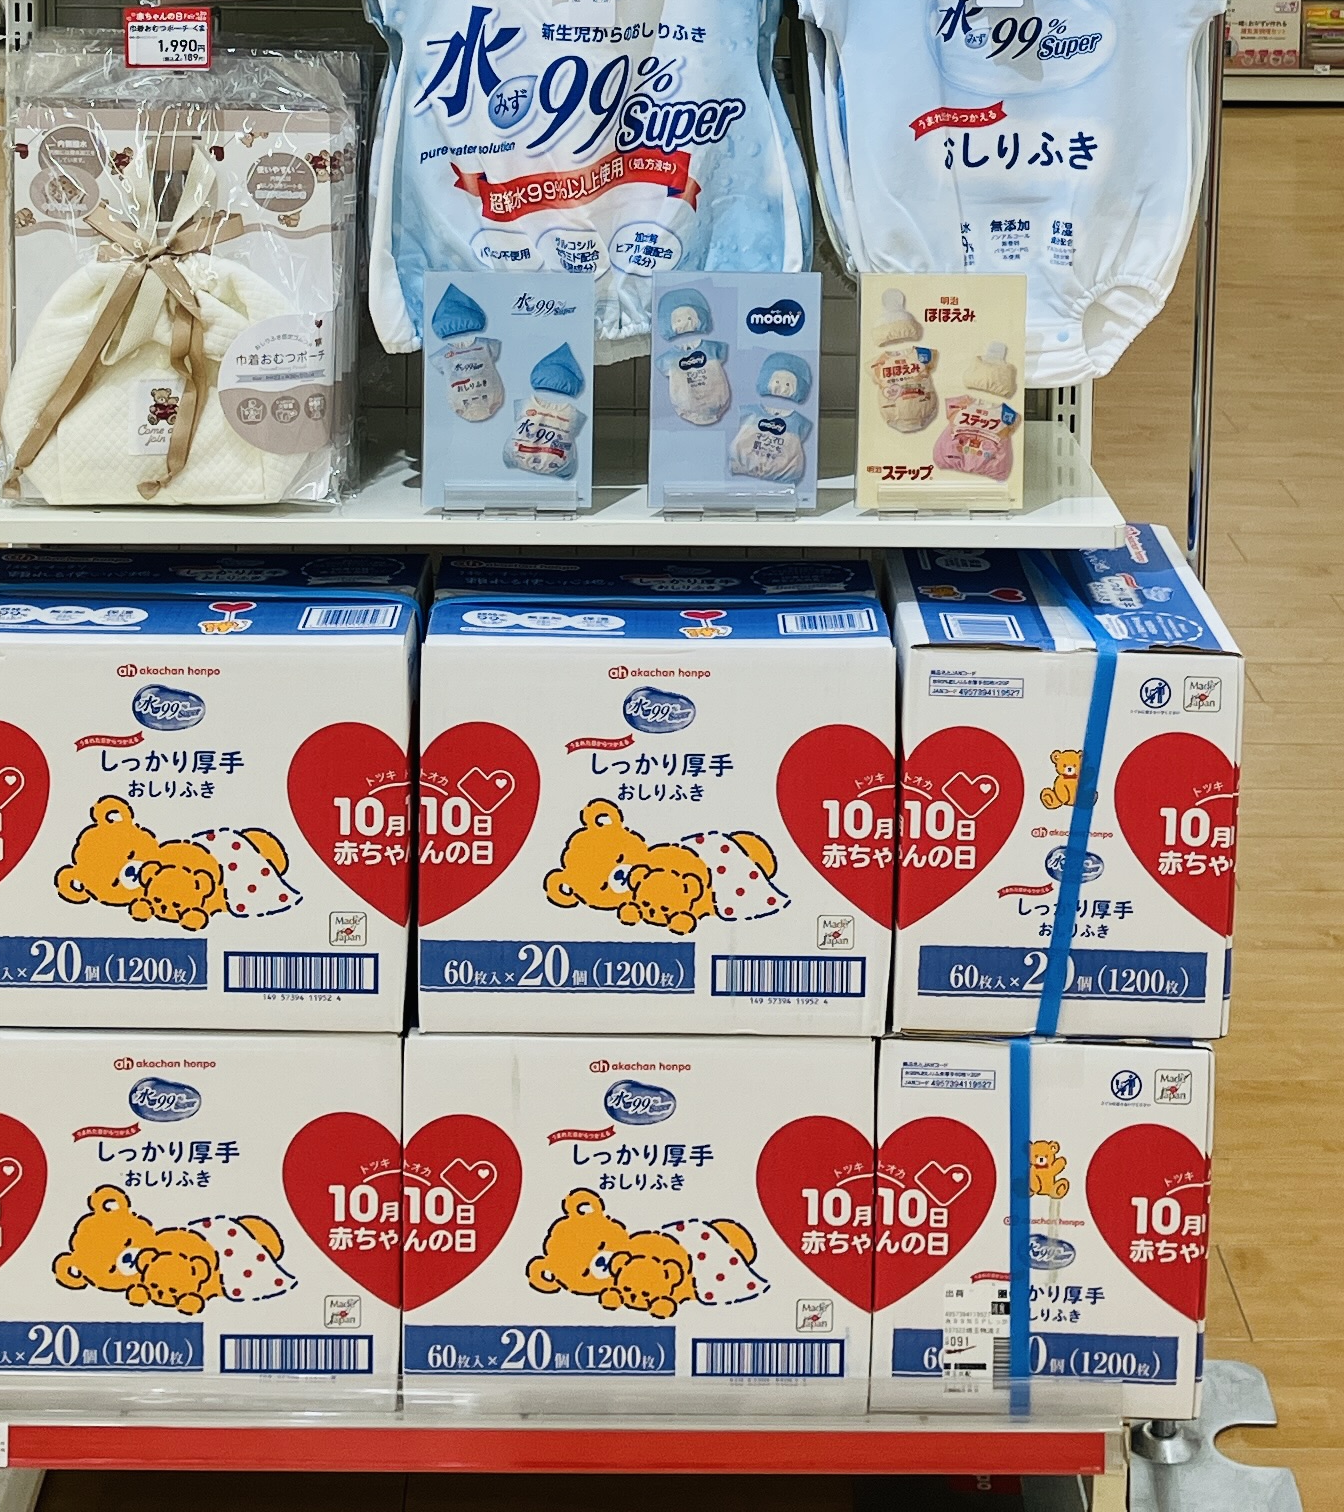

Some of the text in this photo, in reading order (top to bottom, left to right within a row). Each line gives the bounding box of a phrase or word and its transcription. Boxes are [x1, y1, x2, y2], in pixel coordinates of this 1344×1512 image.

[158, 40, 205, 52] 1,990円
[986, 17, 1066, 60] 99%
[1039, 32, 1102, 59] Super
[414, 6, 520, 117] 水
[617, 95, 745, 152] Super
[493, 90, 528, 117] みず
[420, 145, 448, 162] pure
[990, 219, 1030, 232] 無添加
[941, 296, 959, 306] 明治
[750, 310, 801, 330] moony
[925, 308, 976, 324] ほほえみ
[236, 351, 325, 366] 巾着おむつポーチ
[138, 424, 165, 435] Come
[959, 413, 1000, 430] ステップ
[145, 434, 165, 446] join
[882, 465, 933, 481] ステップ
[140, 666, 184, 676] akachan
[187, 666, 220, 677] honpo
[631, 668, 675, 678] akachan
[678, 669, 710, 679] honpo
[101, 751, 244, 774] しっかり厚手
[591, 753, 734, 776] しっかり厚手
[128, 781, 215, 798] おしりふき
[618, 784, 705, 801] おしりふき
[137, 1059, 180, 1068] akachan
[184, 1059, 216, 1069] honpo
[612, 1062, 655, 1071] akachan
[659, 1062, 691, 1072] honpo
[99, 1141, 239, 1163] しっかり厚手
[573, 1144, 714, 1166] しっかり厚手
[125, 1171, 211, 1188] おしりふき
[599, 1174, 685, 1191] おしりふき
